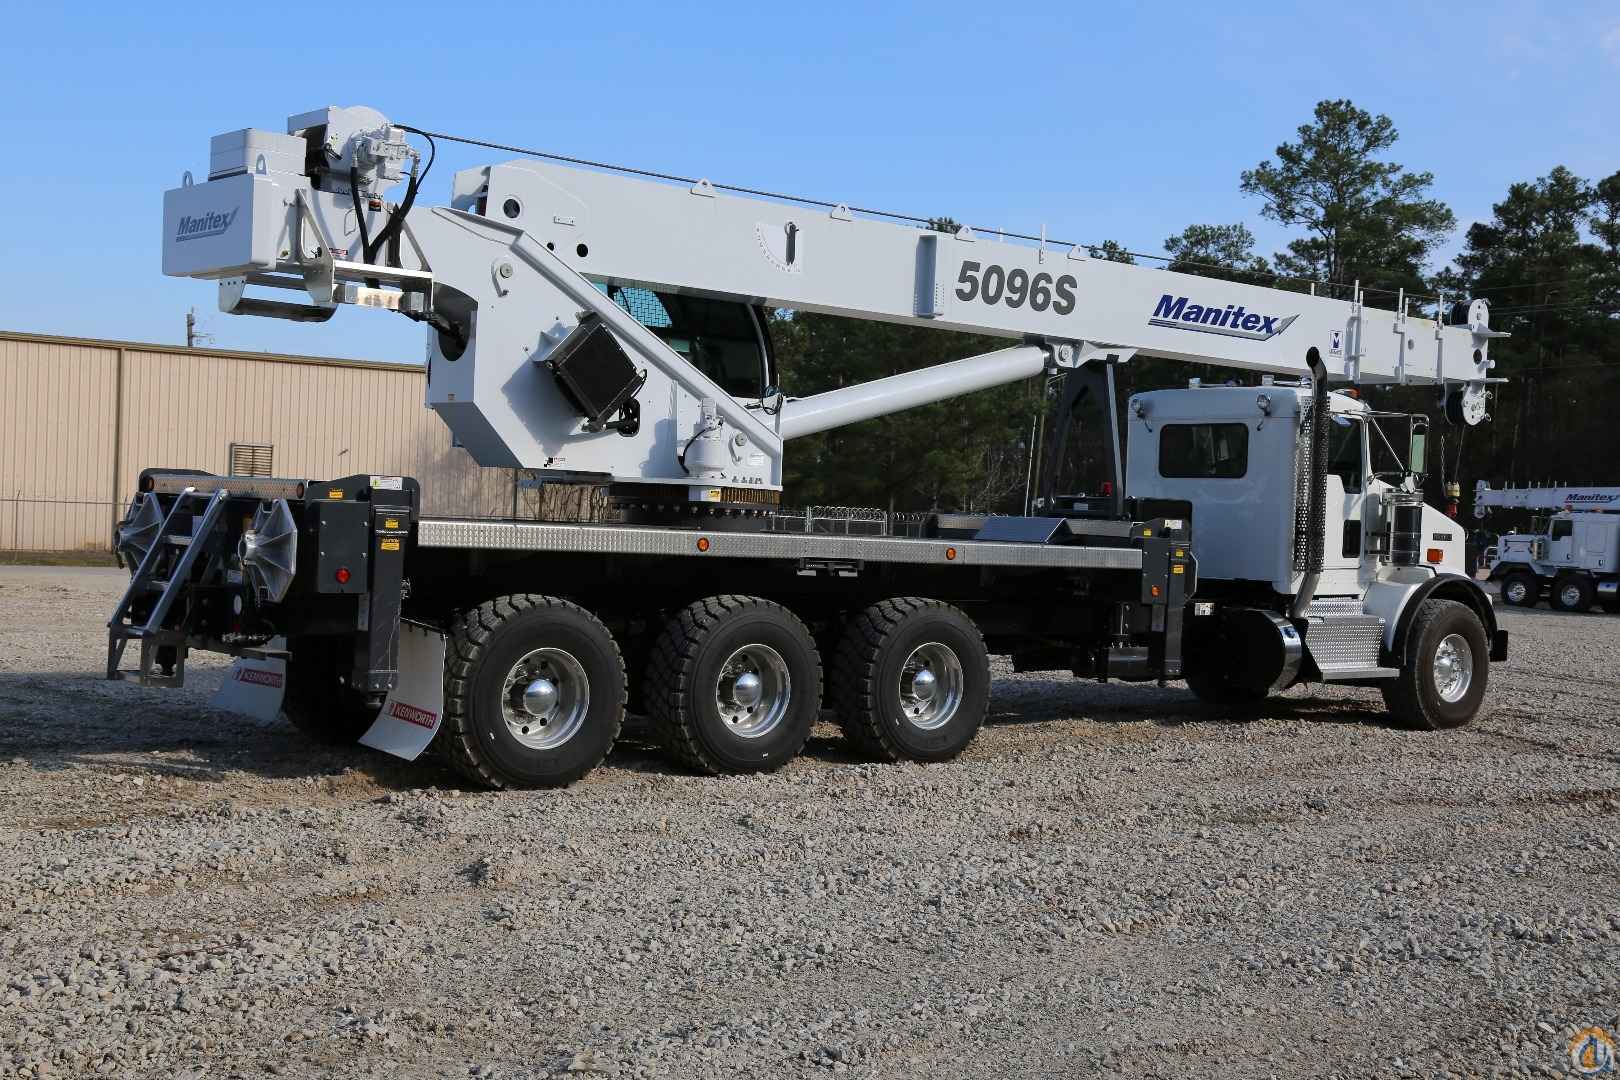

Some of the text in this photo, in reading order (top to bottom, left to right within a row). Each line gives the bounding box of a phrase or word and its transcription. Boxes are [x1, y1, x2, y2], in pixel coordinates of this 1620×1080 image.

[177, 211, 230, 235] Manitex
[955, 260, 1078, 315] 5096S
[1152, 294, 1279, 334] Manitex
[396, 705, 435, 727] KENWORTH
